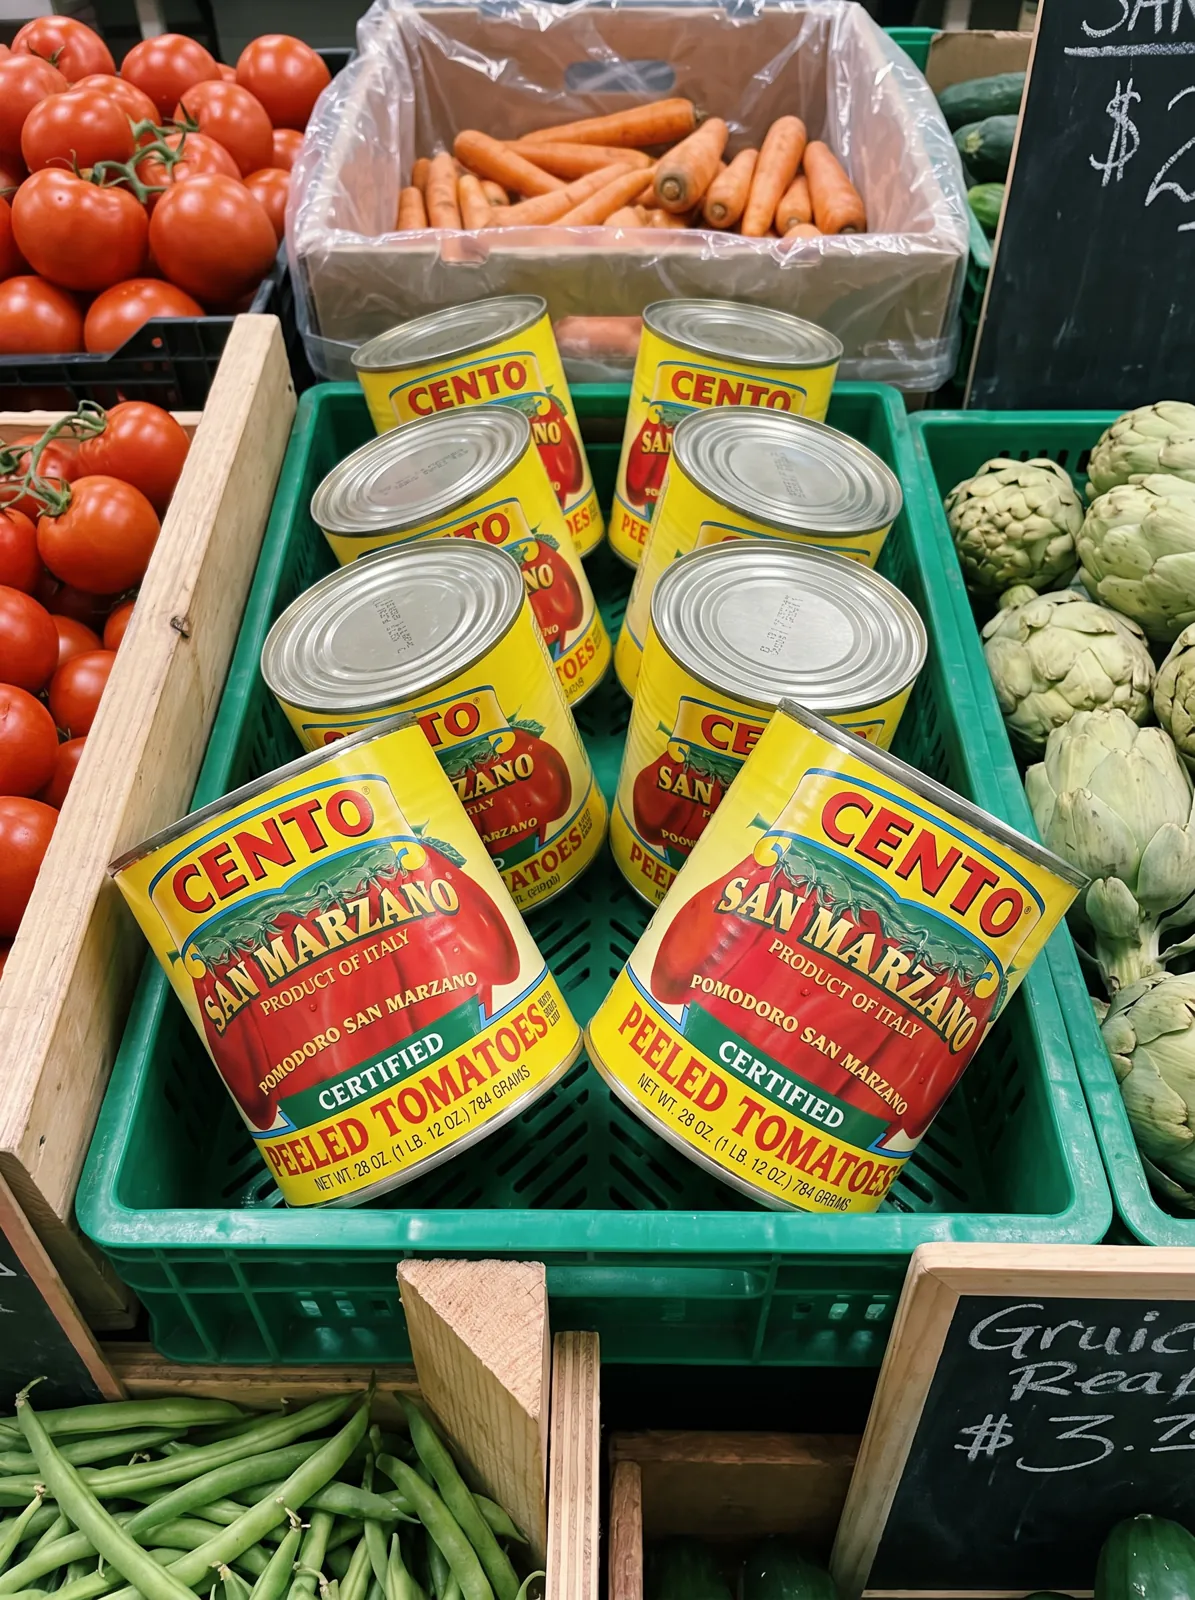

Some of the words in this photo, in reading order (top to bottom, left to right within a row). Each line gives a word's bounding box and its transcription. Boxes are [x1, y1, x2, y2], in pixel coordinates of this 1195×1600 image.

[408, 361, 527, 417] CENTO
[671, 370, 792, 413] CENTO
[443, 512, 511, 545] TO
[657, 765, 714, 806] SAN
[173, 789, 374, 914] CENTO
[502, 827, 583, 892] ATOES
[821, 791, 1024, 938] CENTO
[203, 960, 261, 1036] SAN
[252, 878, 460, 987] MARZANO
[260, 967, 337, 1016] PRODUCT
[338, 953, 361, 976] OF
[365, 928, 411, 966] ITALY
[715, 876, 807, 935] SAN
[800, 906, 978, 1054] MARZANO
[768, 938, 854, 1000] PRODUCT
[851, 992, 880, 1014] OF
[873, 1005, 923, 1040] ITALY
[258, 1027, 341, 1096] POMODORO
[343, 1003, 384, 1034] SAN
[385, 971, 478, 1014] MARZANO
[318, 1032, 444, 1110] CERTIFIED
[690, 974, 799, 1033] POMODORO
[799, 1026, 842, 1060] SAN
[840, 1053, 909, 1116] MARZANO
[718, 1041, 845, 1128] CERTIFIED
[264, 1117, 369, 1178] PEELED
[370, 1003, 548, 1137] TOMATOES
[618, 1001, 728, 1112] PEELED
[731, 1095, 898, 1197] TOMATOES
[637, 1072, 660, 1097] NET
[657, 1089, 678, 1115] WT.
[677, 1108, 696, 1127] 28
[694, 1120, 714, 1143] OZ.
[714, 1135, 729, 1151] (1
[728, 1143, 748, 1166] LB.
[751, 1158, 767, 1176] 12
[767, 1167, 793, 1191] OZ.)
[792, 1179, 816, 1199] 784
[314, 1173, 334, 1192] NET
[333, 1166, 356, 1185] WT.
[354, 1160, 371, 1178] 28
[370, 1151, 392, 1169] OZ.
[392, 1143, 405, 1163] (1
[405, 1134, 427, 1153] LB.
[427, 1122, 444, 1140] 12
[444, 1107, 471, 1130] OZ.)
[469, 1092, 493, 1115] 784
